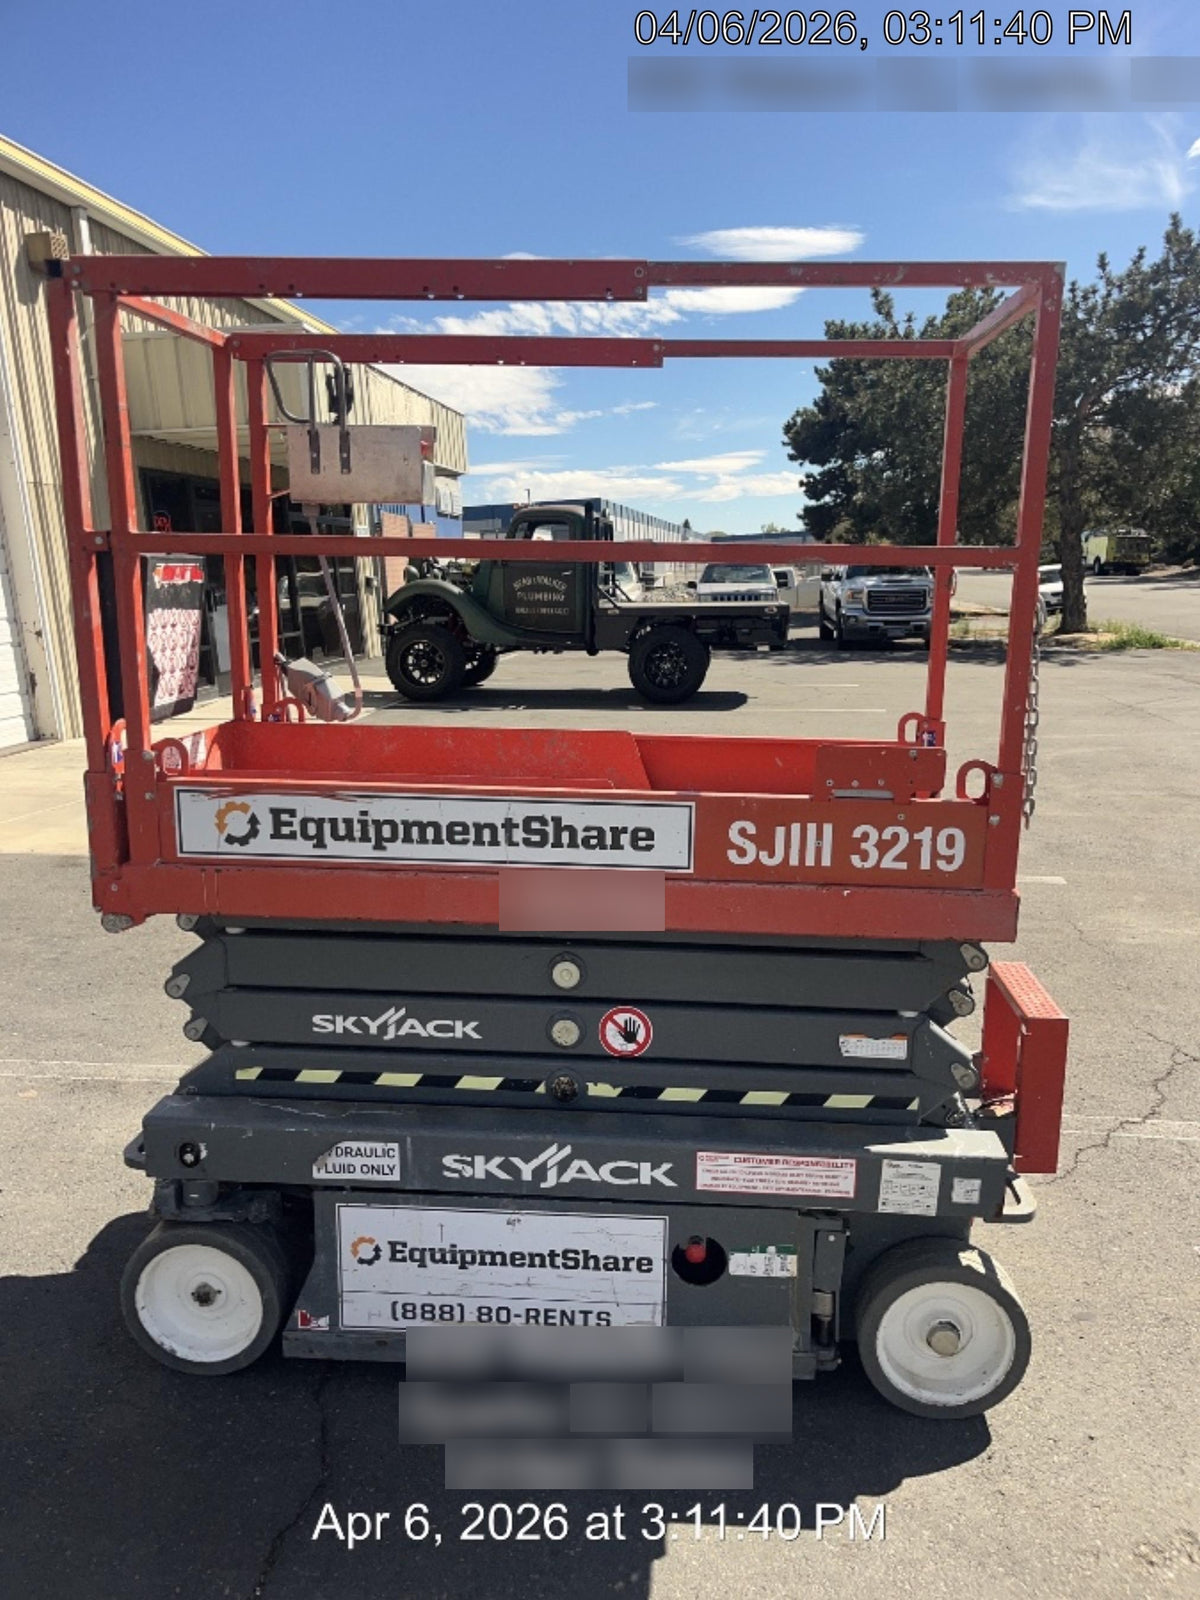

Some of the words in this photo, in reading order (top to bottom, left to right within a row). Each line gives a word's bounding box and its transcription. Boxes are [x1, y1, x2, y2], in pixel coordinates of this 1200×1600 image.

[268, 807, 656, 853] EquipmentShare
[850, 824, 966, 872] 3219
[311, 1006, 482, 1041] SKYJACK
[328, 1146, 396, 1159] DRAULIC
[441, 1142, 678, 1189] SKYJACK
[360, 1164, 397, 1176] ONLY
[387, 1241, 654, 1274] EquipmentShare
[391, 1300, 464, 1323] (888)
[477, 1305, 611, 1327] 80-RENTS
